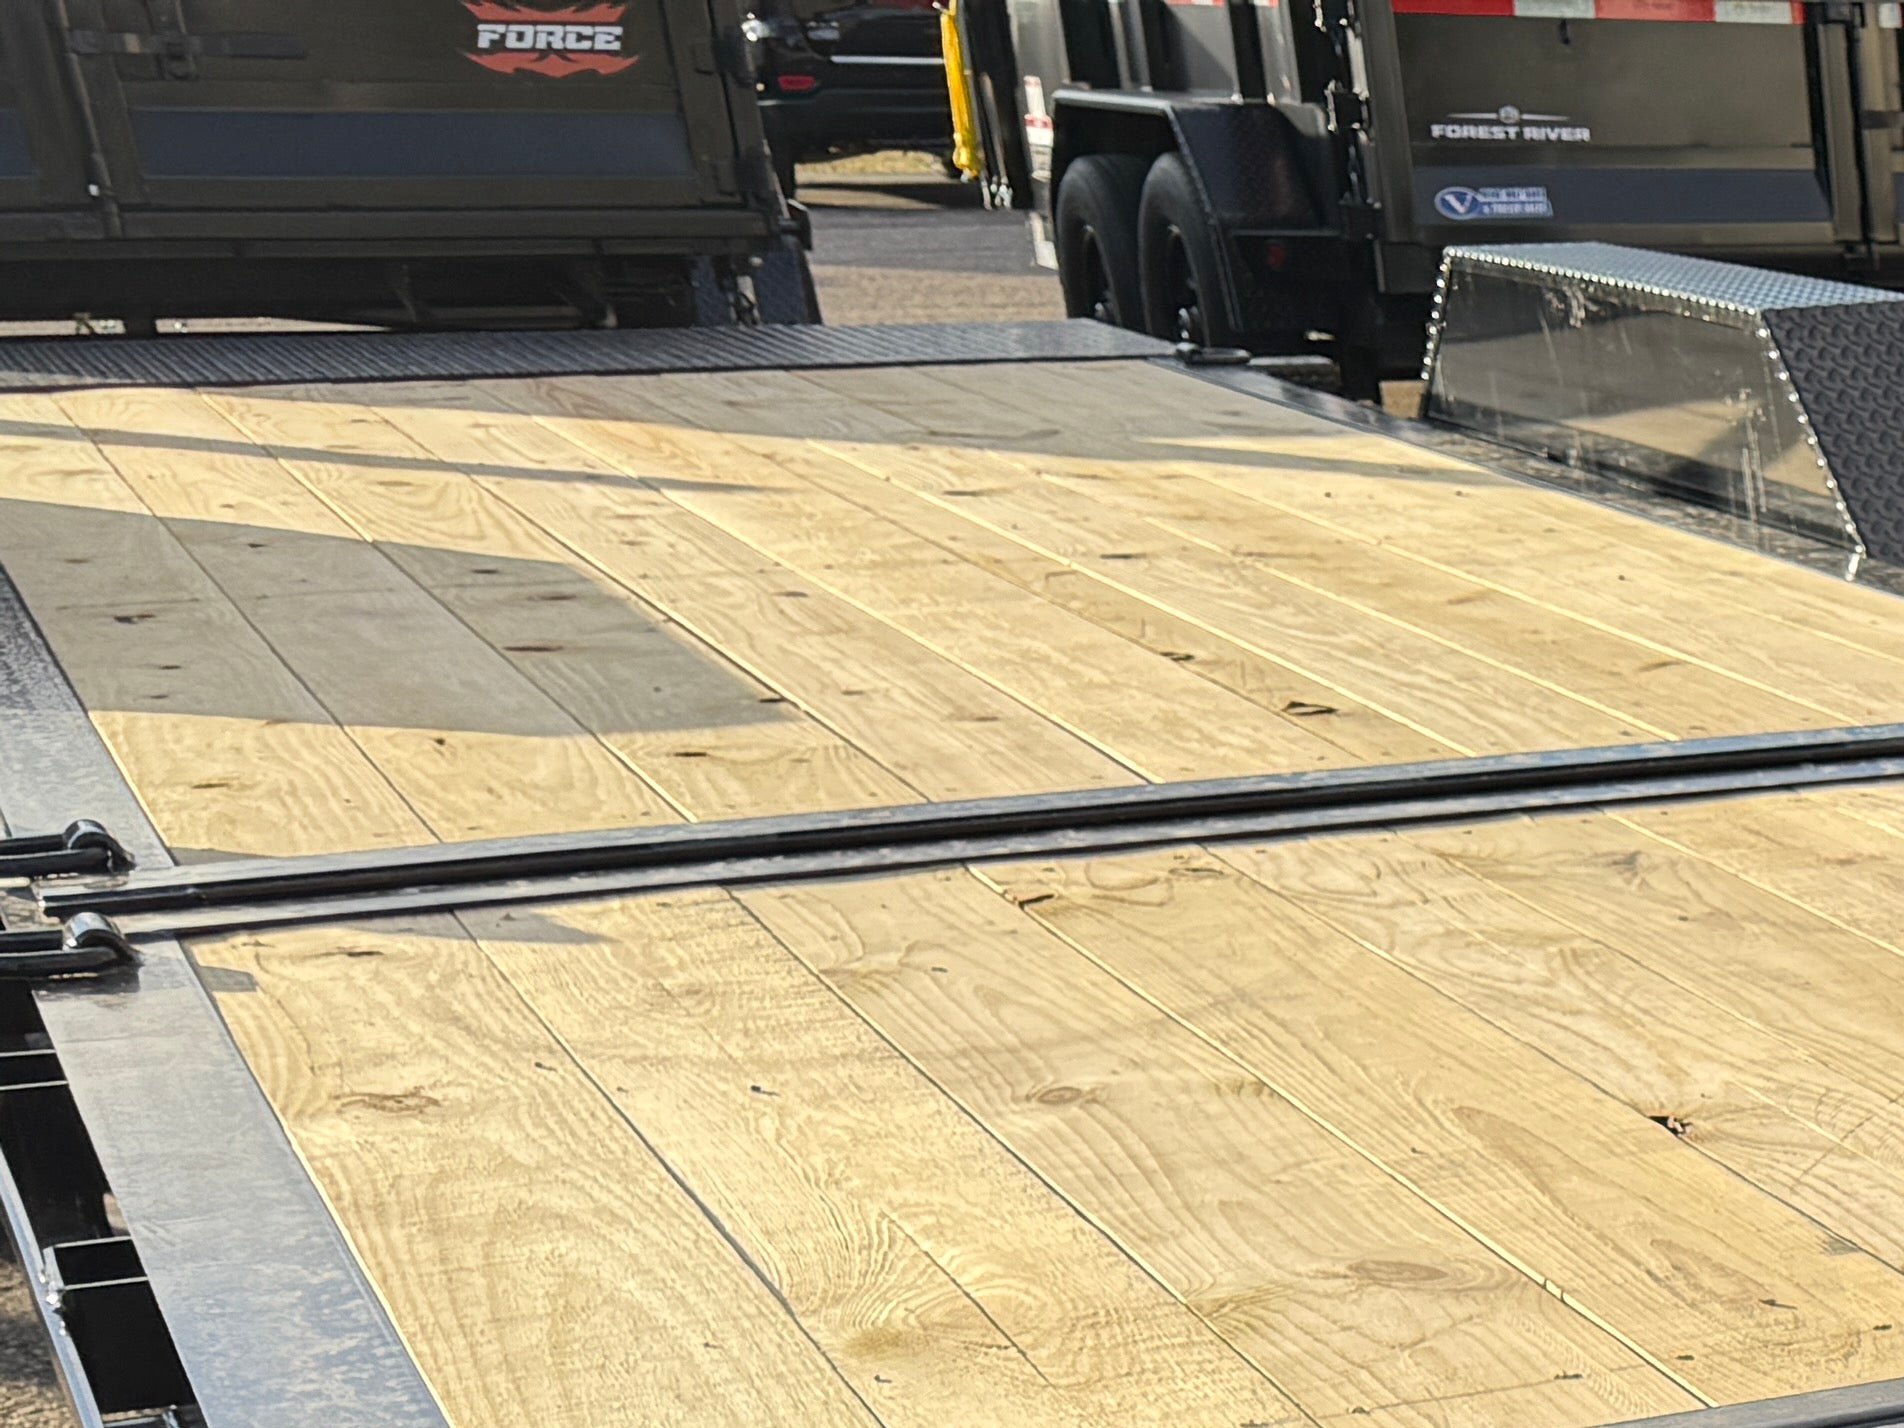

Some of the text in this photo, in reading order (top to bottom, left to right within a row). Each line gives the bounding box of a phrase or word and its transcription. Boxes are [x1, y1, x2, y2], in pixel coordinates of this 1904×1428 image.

[477, 24, 623, 50] FORCE
[1430, 124, 1591, 142] FOREST RIVER
